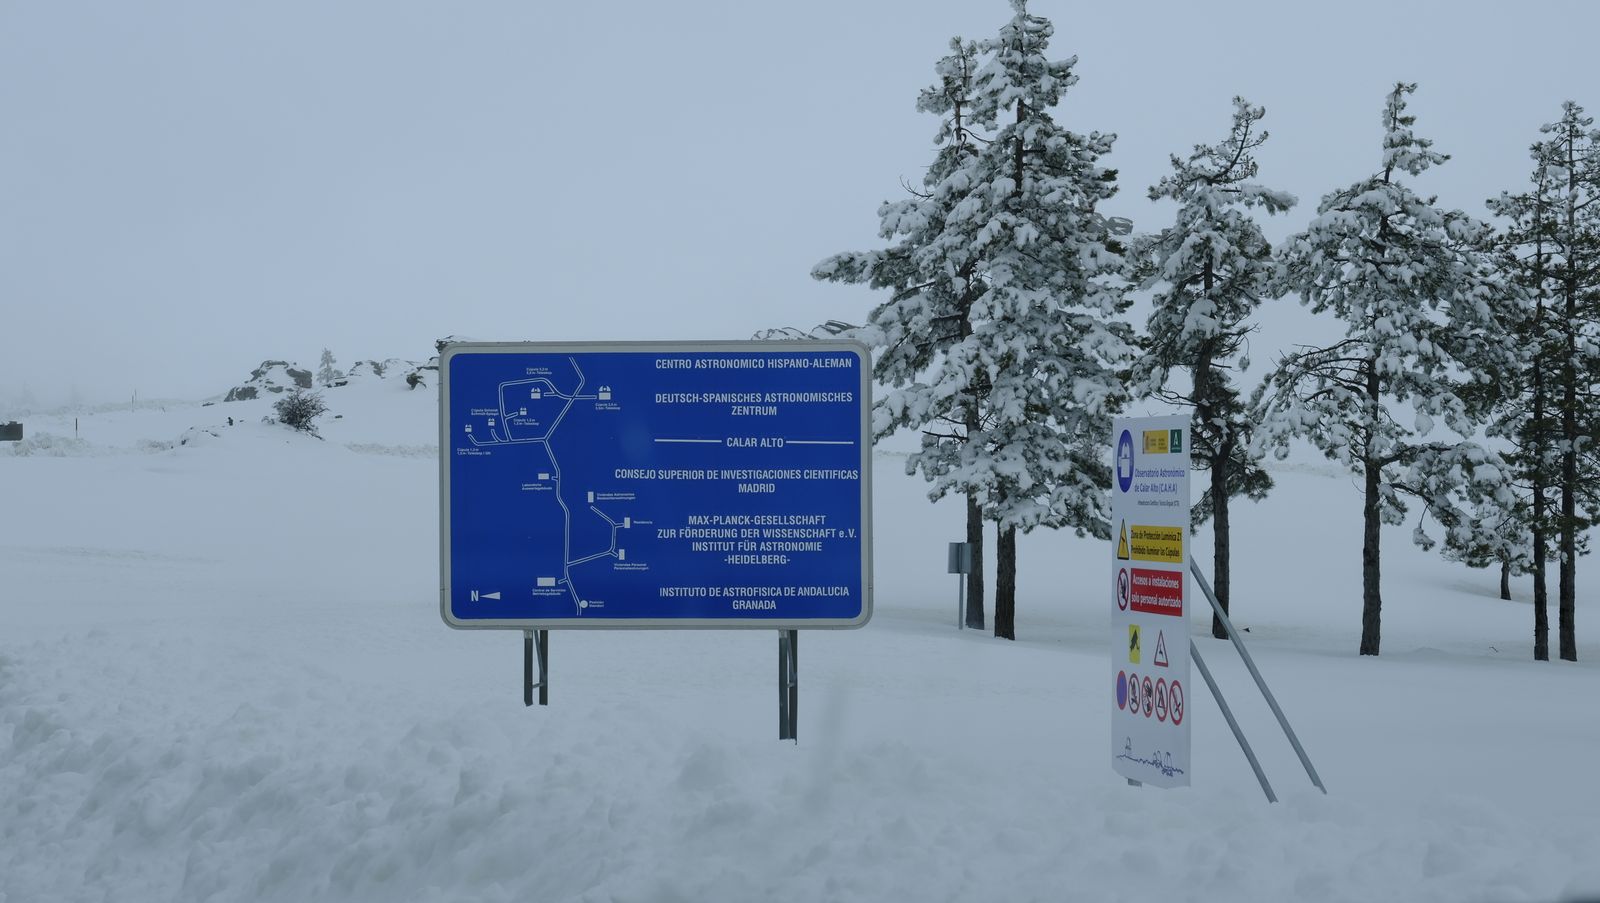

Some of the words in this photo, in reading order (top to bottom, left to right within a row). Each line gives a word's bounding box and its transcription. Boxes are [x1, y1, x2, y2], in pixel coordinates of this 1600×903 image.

[656, 359, 691, 368] CENTRO
[695, 359, 764, 368] ASTRONOMICO
[768, 359, 851, 368] HISPANO-ALEMAN
[656, 393, 761, 403] DEUTSCH-SPANISCHES
[765, 392, 852, 402] ASTRONOMISCHES
[732, 406, 776, 415] ZENTRUM
[727, 438, 757, 447] CALAR
[761, 438, 783, 447] ALTO
[615, 469, 655, 479] CONSEJO
[658, 470, 704, 479] SUPERIOR
[707, 470, 718, 479] DE
[721, 470, 801, 479] INVESTIGACIONES
[804, 470, 858, 479] CIENTIFICAS
[1135, 468, 1159, 478] Observatorio
[739, 484, 775, 492] MADRID
[1135, 484, 1139, 492] de
[1140, 483, 1150, 492] Calar
[1150, 483, 1158, 492] Alto
[689, 516, 825, 525] MAX-PLANCK-GESELLSCHAFT
[658, 529, 676, 538] ZUR
[680, 527, 737, 538] FÖRDERUNG
[741, 529, 759, 538] DER
[763, 529, 836, 538] WISSENSCHAFT
[839, 529, 856, 537] e.V.
[693, 542, 735, 551] INSTITUT
[738, 540, 756, 551] FÜR
[760, 542, 821, 551] ASTRONOMIE
[725, 555, 790, 564] -HEIDELBERG-
[1132, 573, 1148, 586] Accesos
[1152, 575, 1179, 589] instalaciones
[471, 591, 478, 601] N
[660, 587, 706, 596] INSTITUTO
[709, 588, 720, 596] DE
[723, 587, 782, 596] ASTROFISICA
[784, 587, 795, 596] DE
[798, 587, 849, 596] ANDALUCIA
[733, 600, 776, 609] GRANADA
[1140, 594, 1158, 606] personal
[1158, 596, 1182, 608] autorizado
